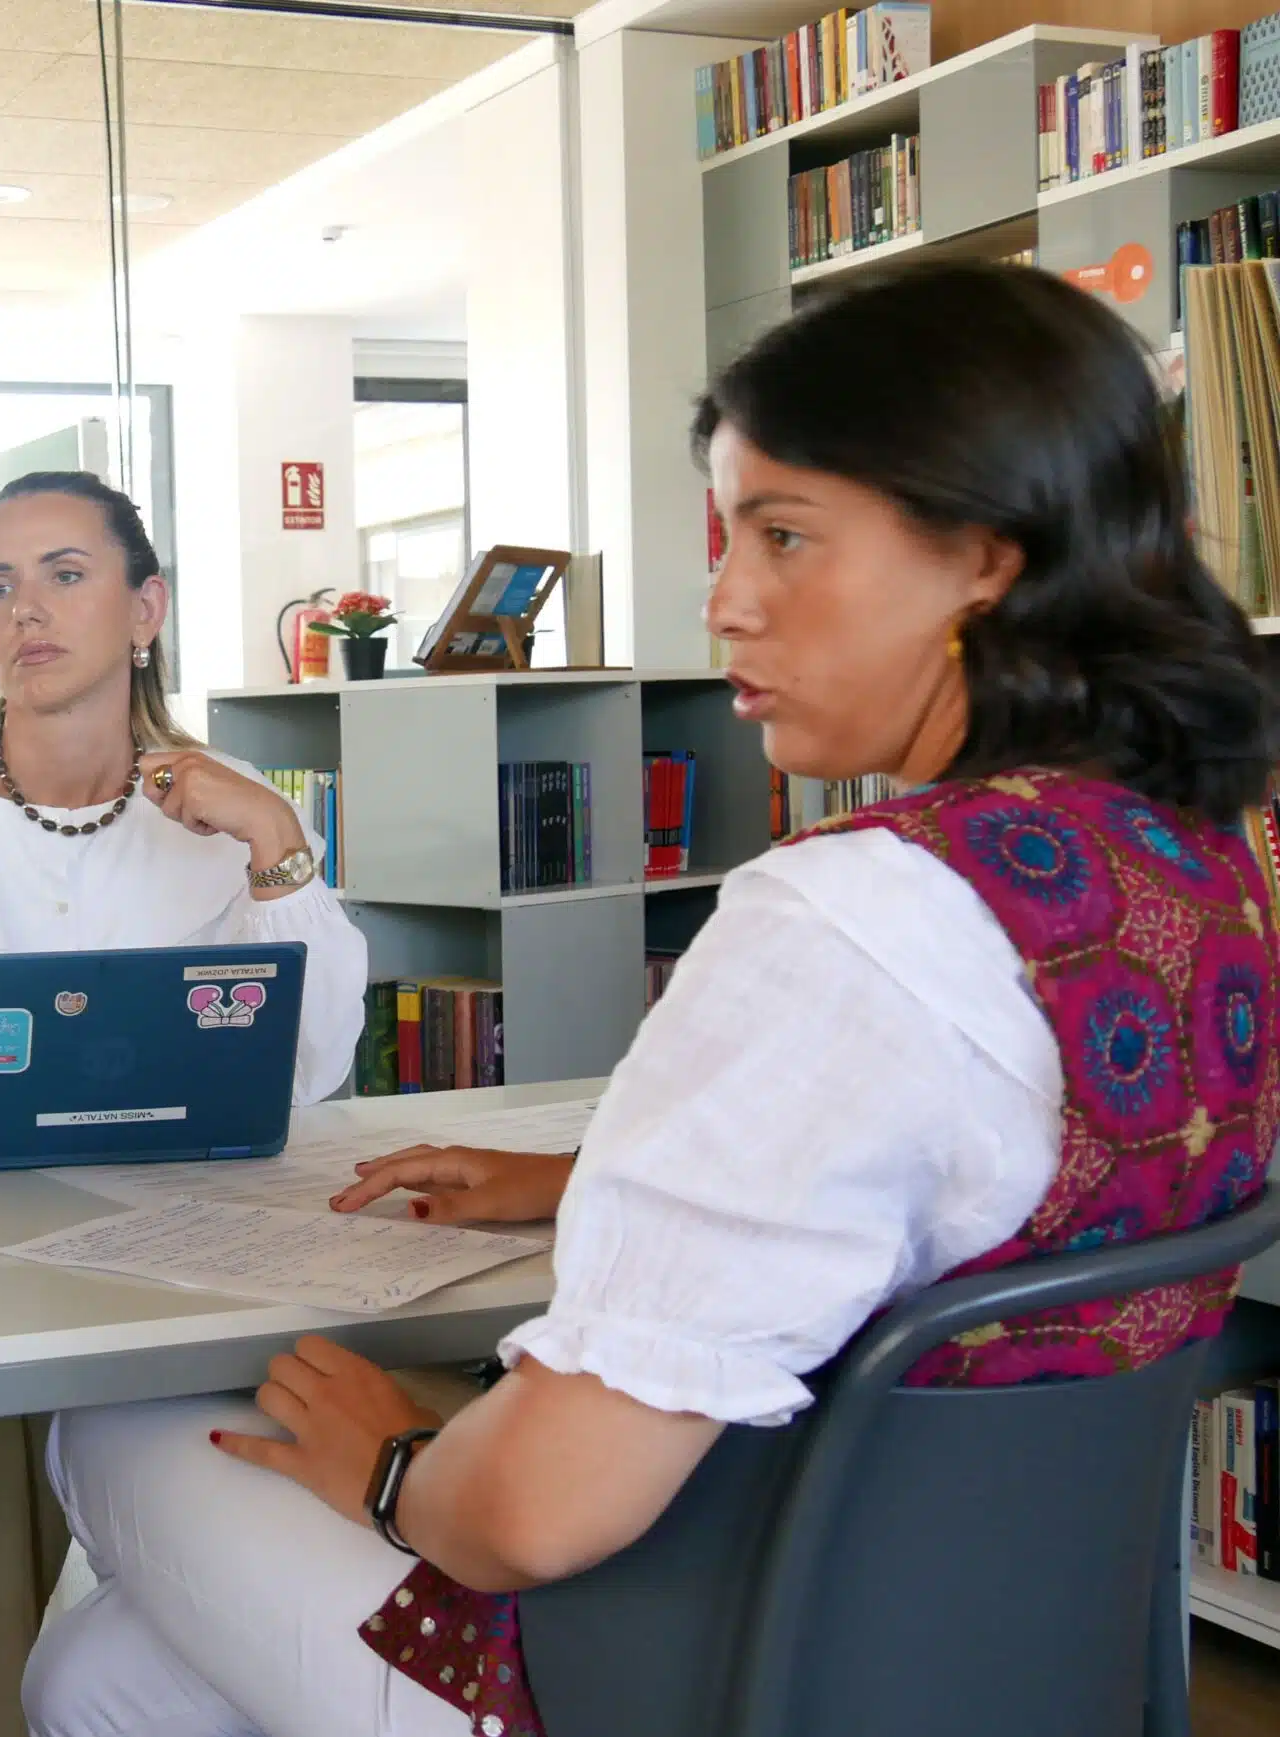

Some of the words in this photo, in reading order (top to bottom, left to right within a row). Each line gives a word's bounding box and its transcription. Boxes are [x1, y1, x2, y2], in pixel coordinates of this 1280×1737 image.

[231, 967, 267, 975] NATALIA
[78, 1113, 118, 1122] NATALY
[120, 1111, 146, 1120] MISS
